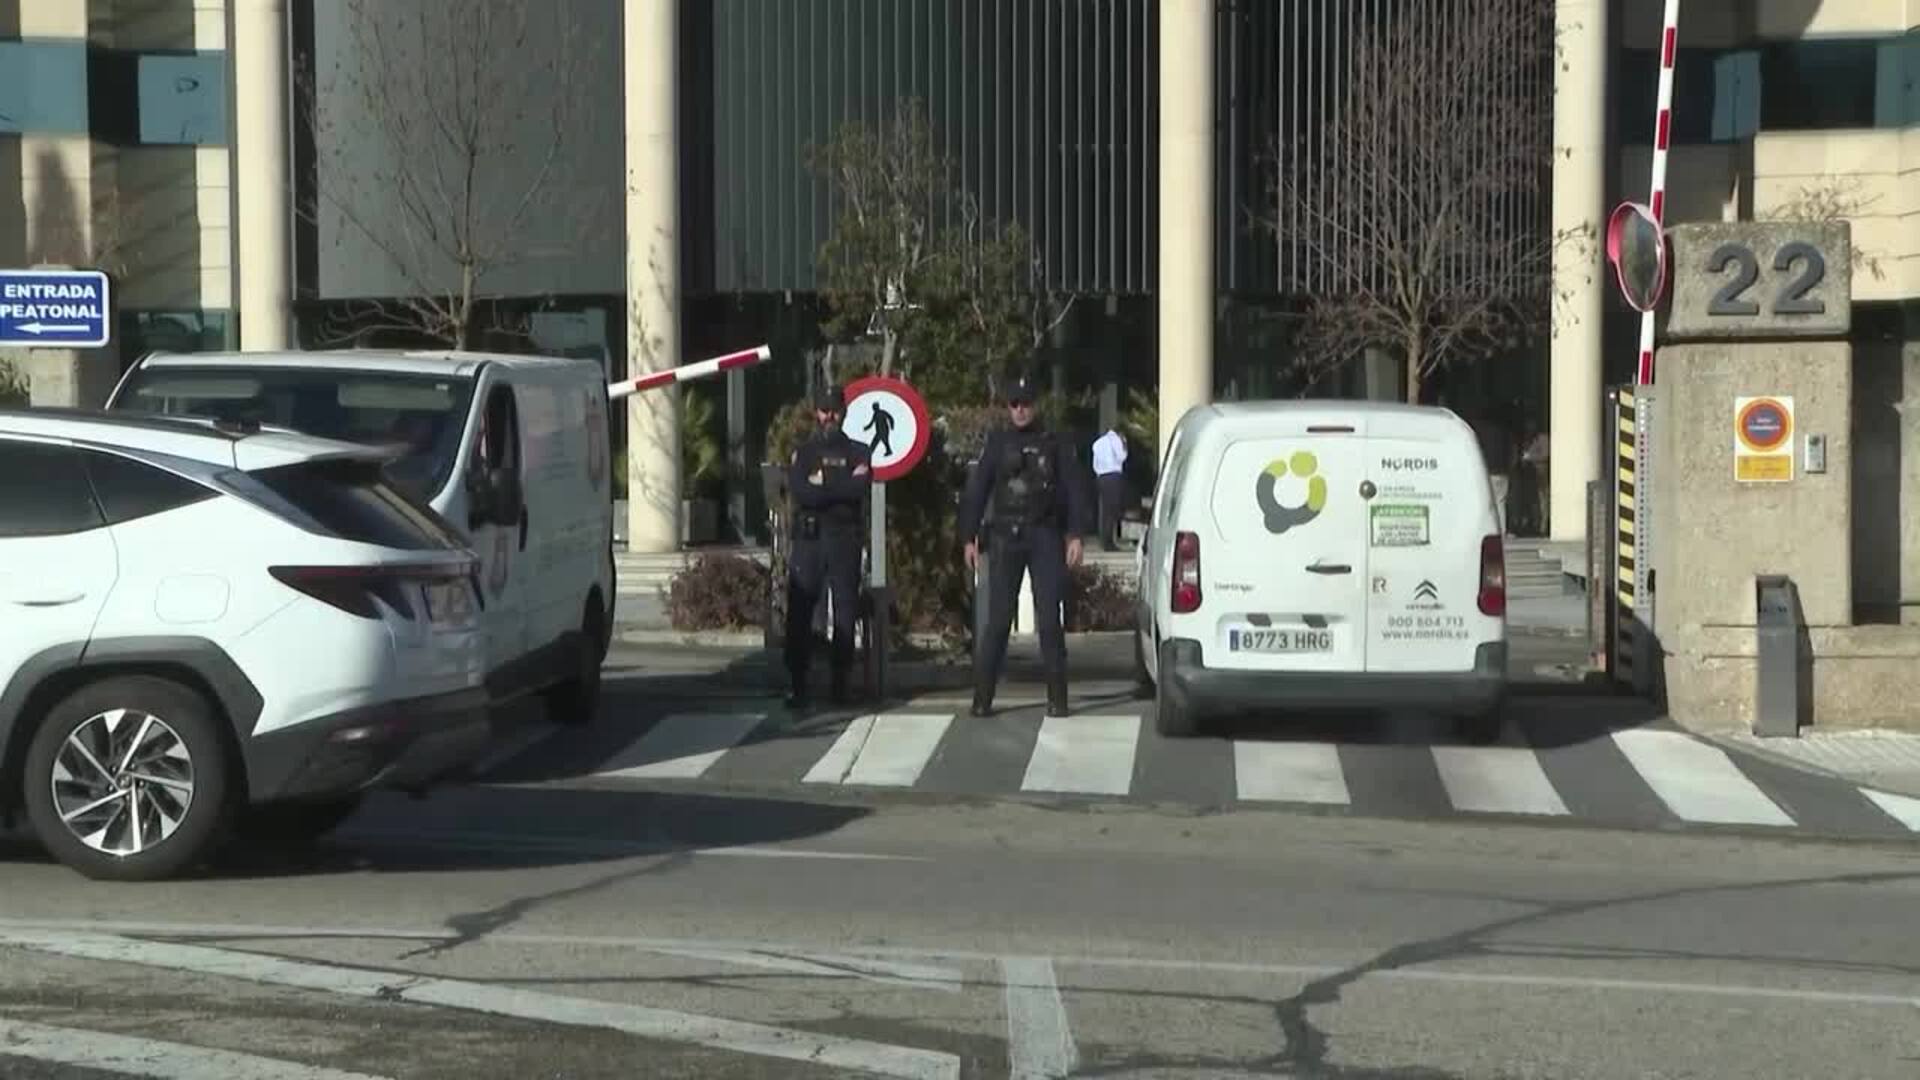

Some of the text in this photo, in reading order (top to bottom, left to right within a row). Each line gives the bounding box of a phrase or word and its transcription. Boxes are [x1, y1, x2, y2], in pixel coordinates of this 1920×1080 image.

[1707, 240, 1825, 315] 22
[4, 284, 96, 299] ENTRADA
[0, 304, 102, 319] PEATONAL
[1242, 631, 1330, 650] 8773 HRG
